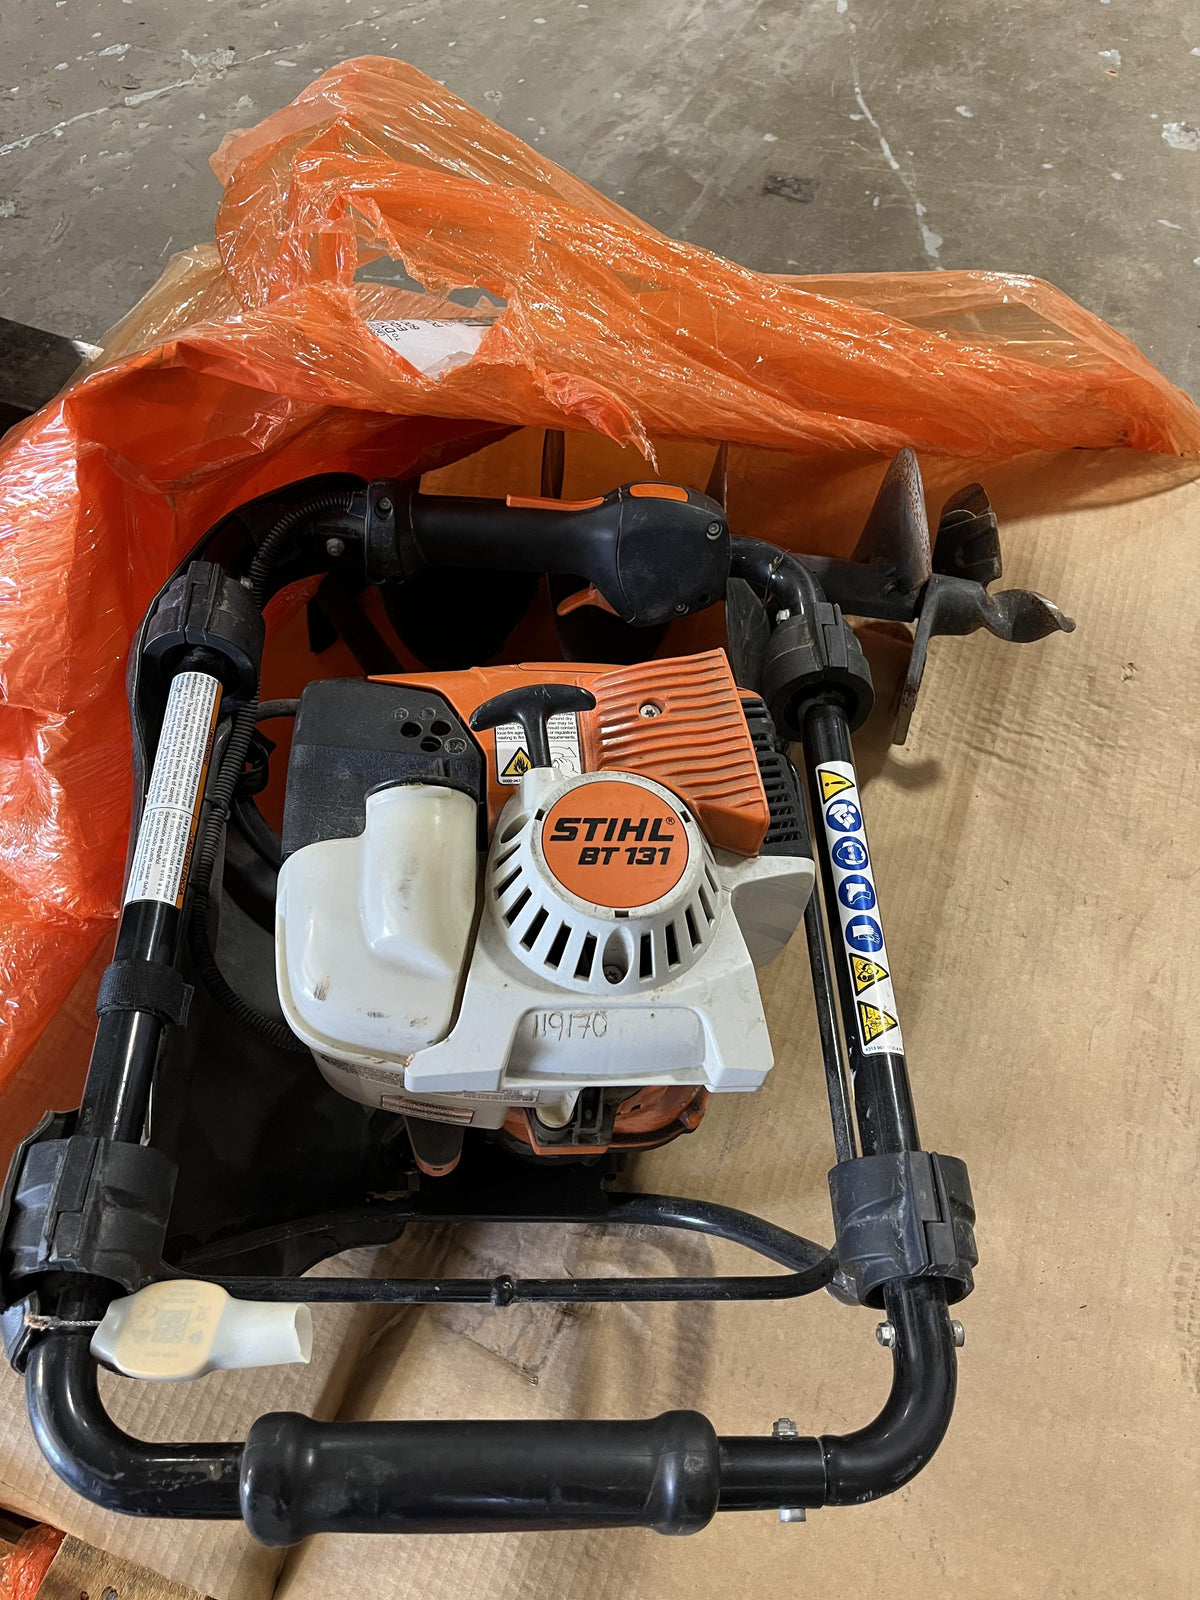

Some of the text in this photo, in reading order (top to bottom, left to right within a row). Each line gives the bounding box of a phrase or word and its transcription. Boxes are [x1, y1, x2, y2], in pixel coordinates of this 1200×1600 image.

[578, 847, 671, 865] BT 131
[532, 1010, 608, 1041] 119170
